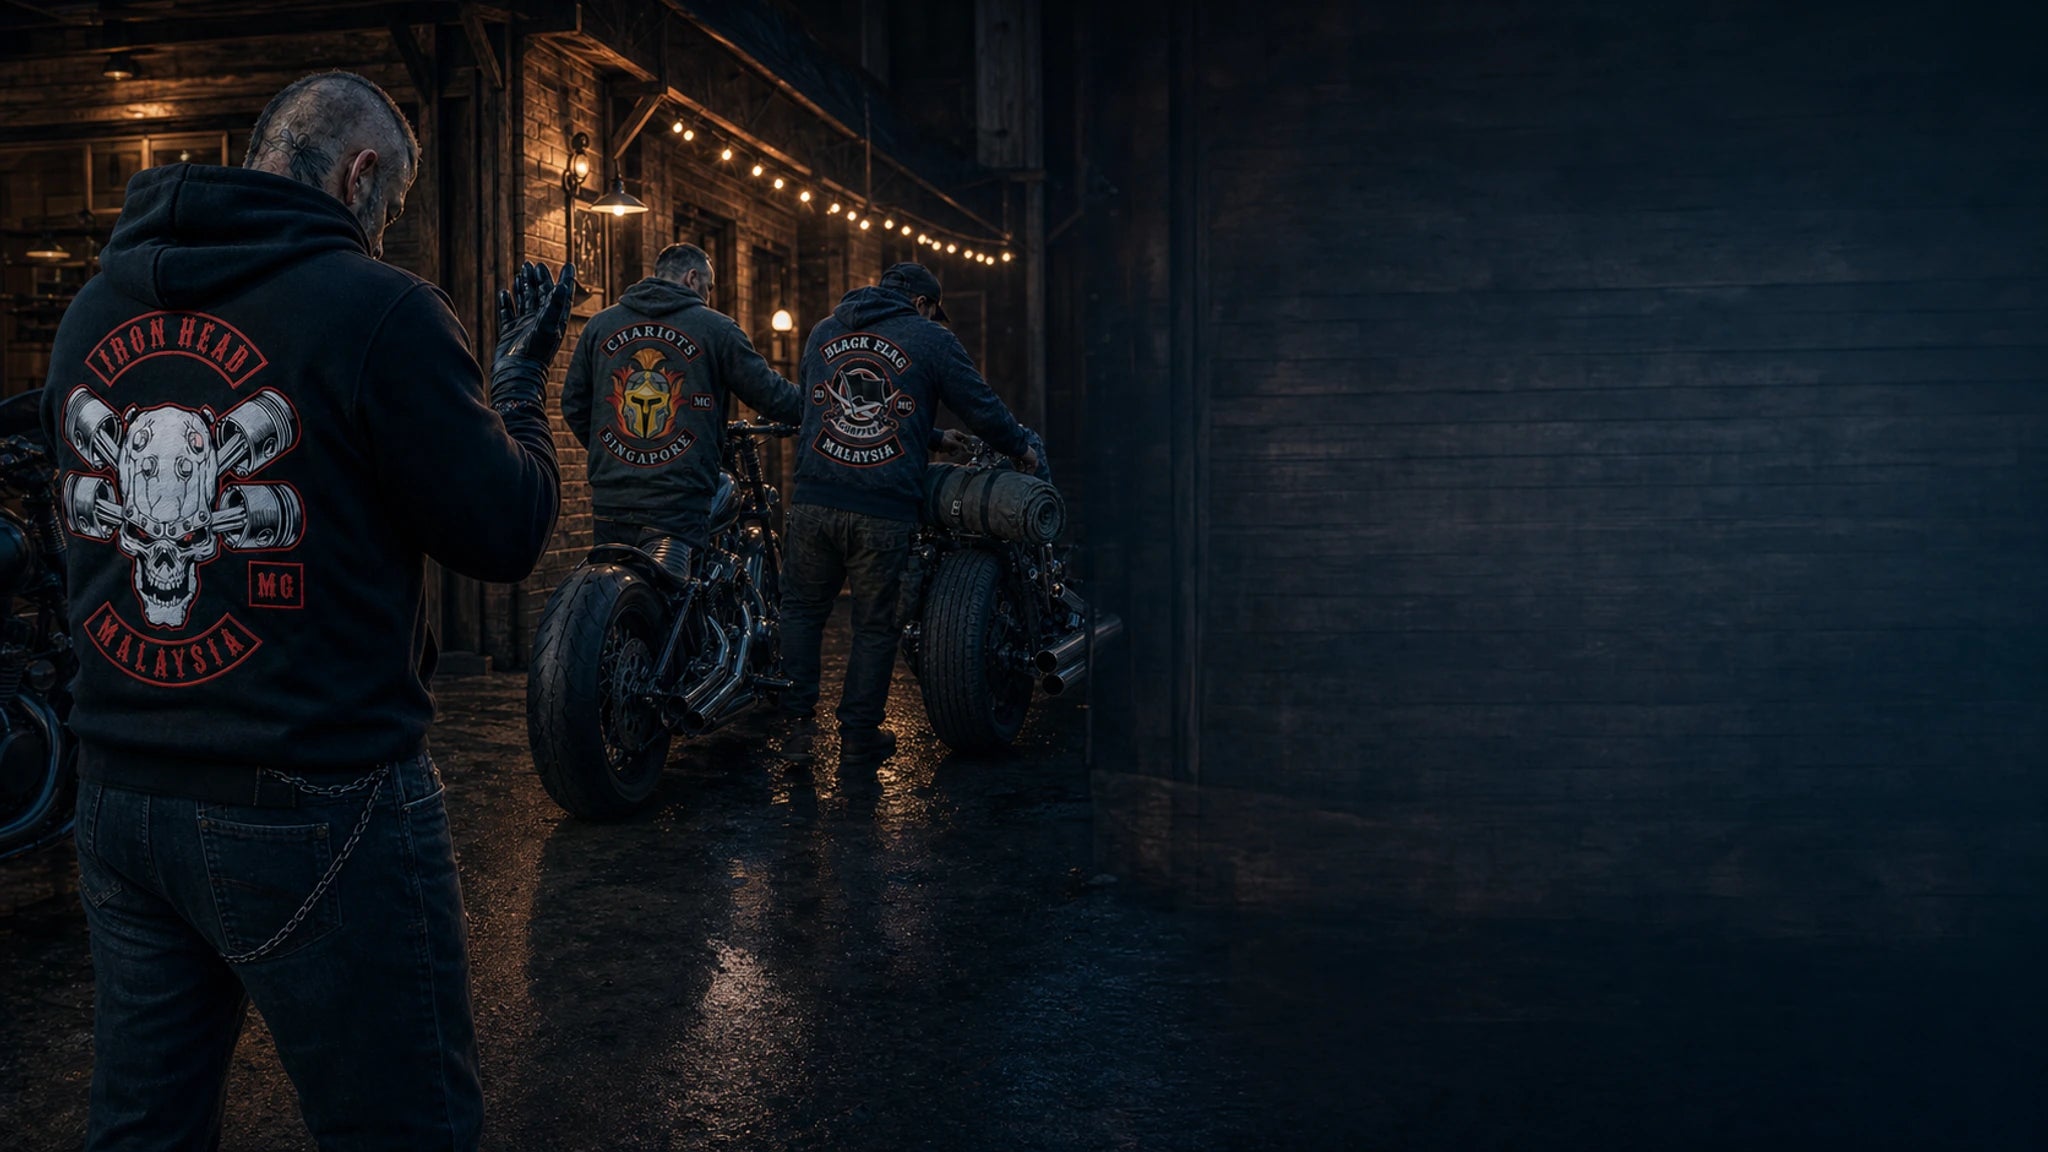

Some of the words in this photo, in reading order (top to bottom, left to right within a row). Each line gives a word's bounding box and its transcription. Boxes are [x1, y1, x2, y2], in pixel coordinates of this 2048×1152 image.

[98, 317, 165, 374] IRON
[178, 317, 249, 373] HEAD
[607, 325, 696, 356] CHARIOTS
[873, 340, 907, 369] FLAG
[694, 396, 710, 406] MC
[602, 432, 691, 465] SINGAPORE
[822, 438, 894, 463] MALAYSIA
[97, 614, 244, 679] MALAYSIA
